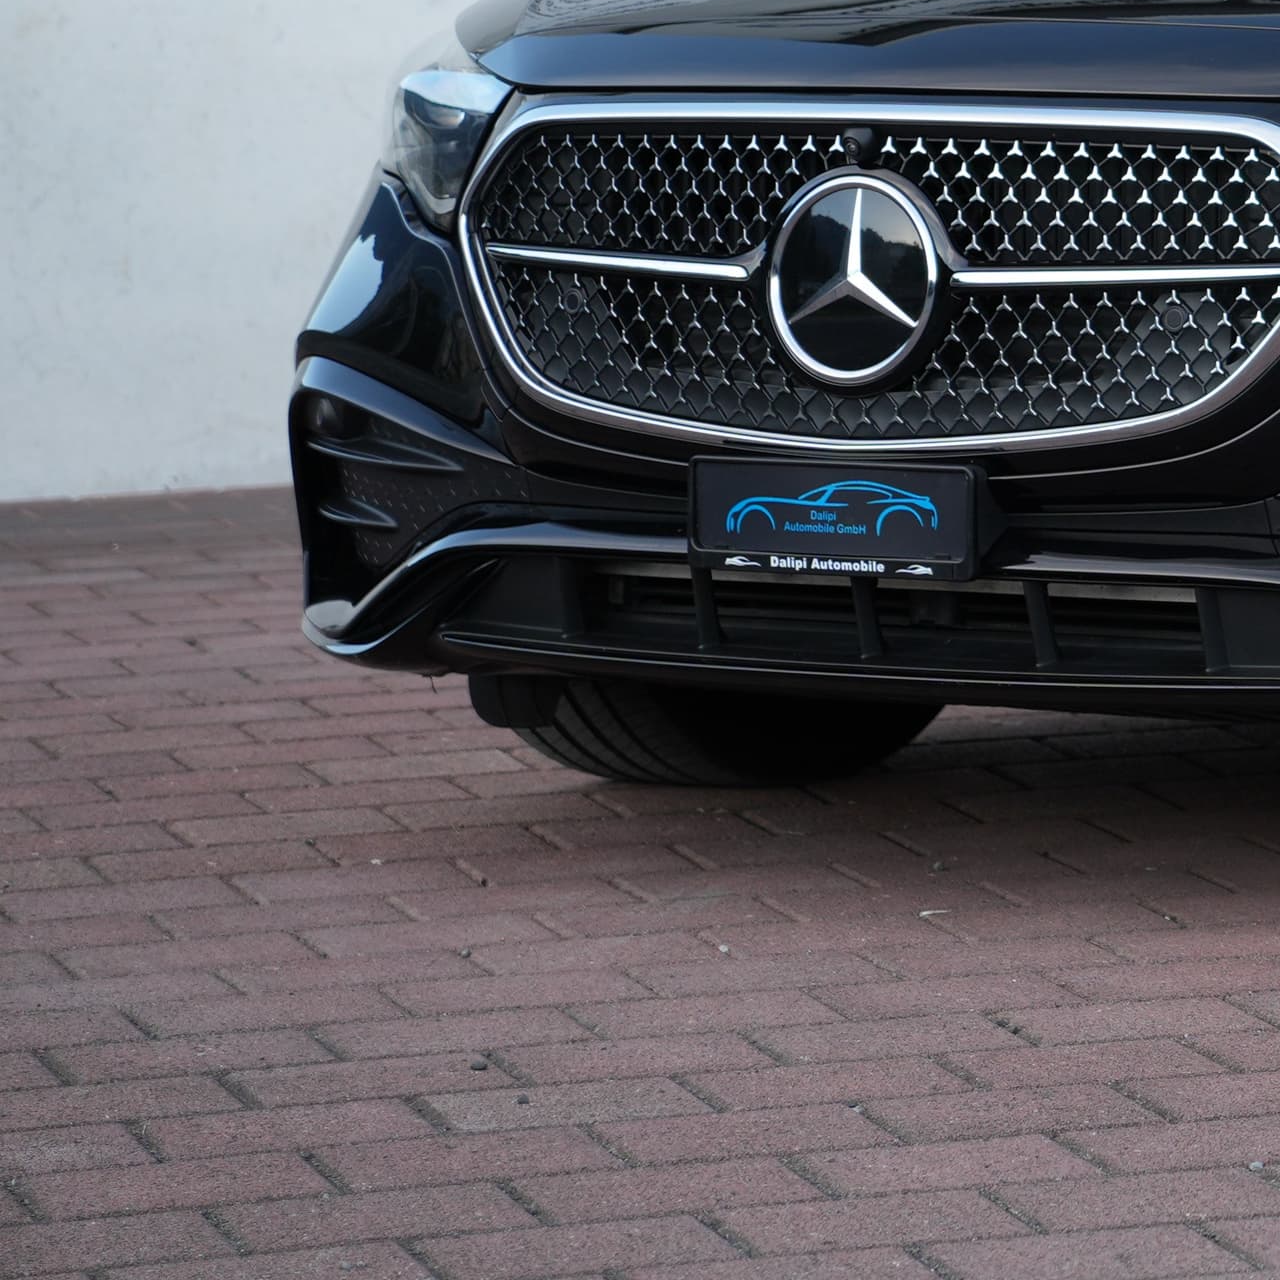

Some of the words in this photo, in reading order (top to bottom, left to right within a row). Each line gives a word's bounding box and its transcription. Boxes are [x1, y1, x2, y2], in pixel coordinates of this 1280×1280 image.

[810, 510, 837, 523] Dalipi
[783, 521, 836, 534] Automobile
[836, 523, 867, 535] GmbH
[769, 555, 807, 571] Dalipi
[810, 558, 885, 573] Automobile
